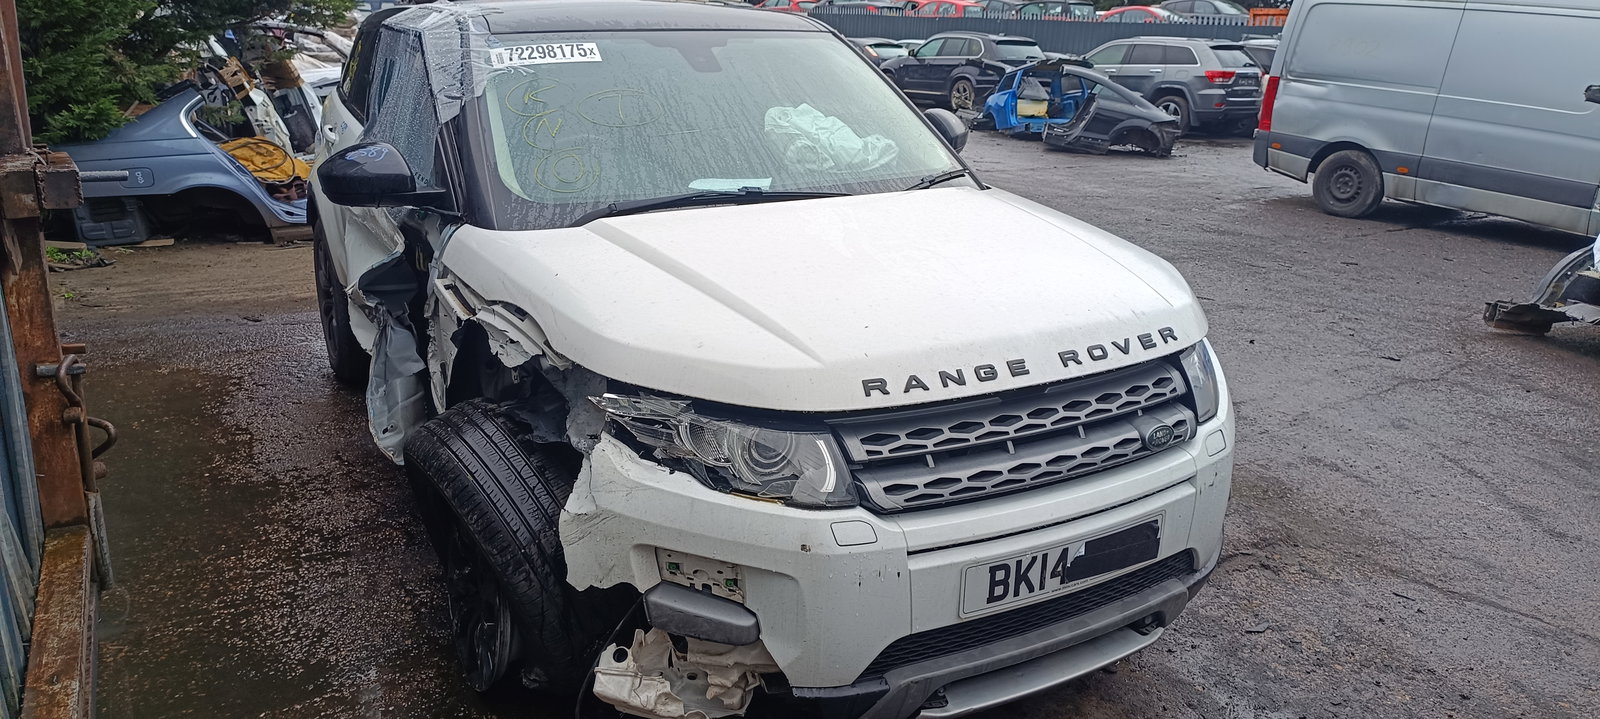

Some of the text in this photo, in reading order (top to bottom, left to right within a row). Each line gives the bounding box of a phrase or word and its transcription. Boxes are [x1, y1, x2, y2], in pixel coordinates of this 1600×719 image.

[862, 326, 1179, 397] RANGE ROVER
[986, 546, 1070, 605] BK14
